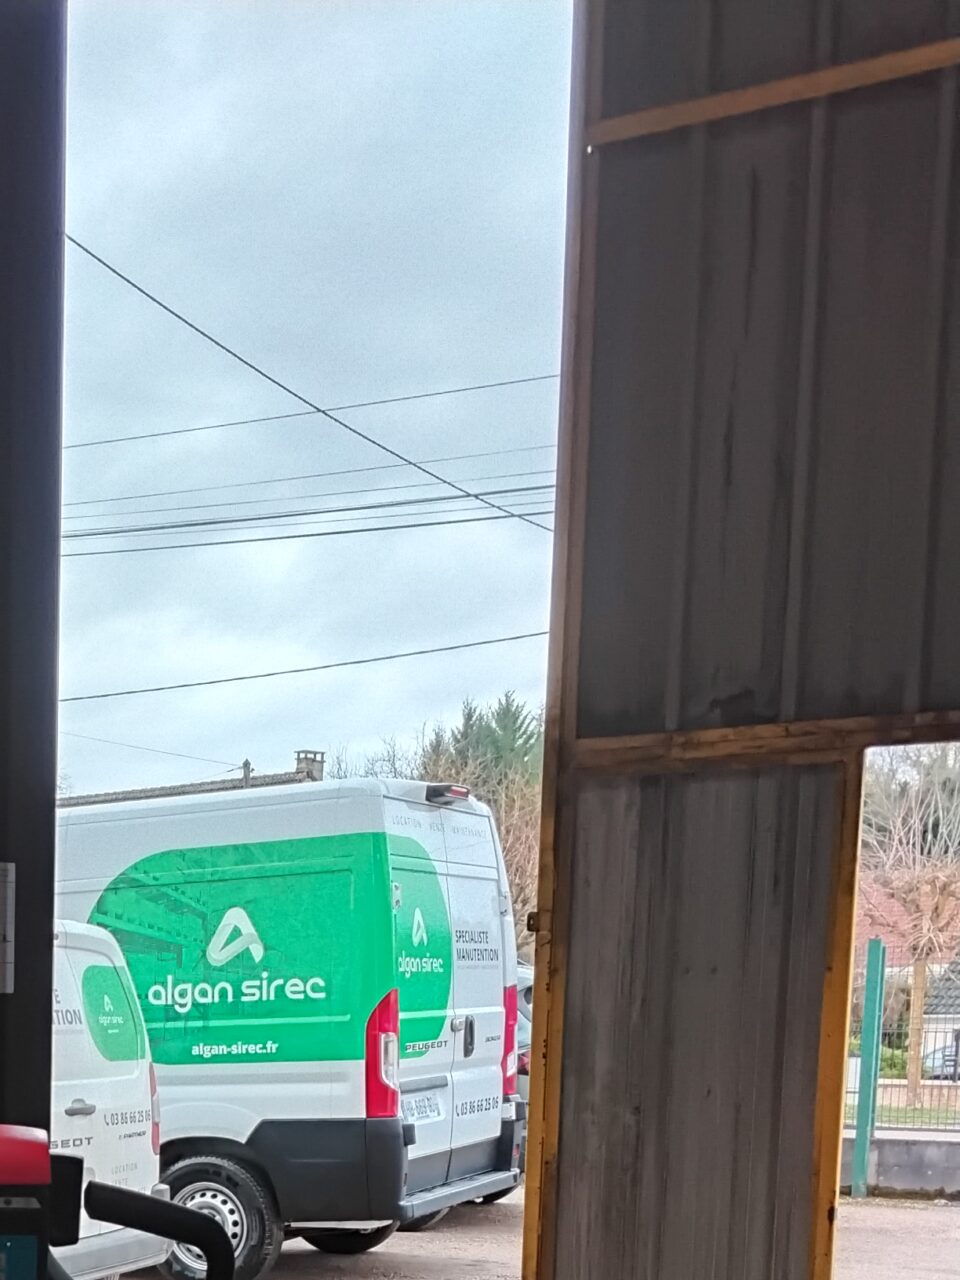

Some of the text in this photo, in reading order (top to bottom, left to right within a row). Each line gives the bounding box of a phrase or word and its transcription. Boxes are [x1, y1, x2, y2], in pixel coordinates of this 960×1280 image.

[456, 948, 499, 962] MANUTENTION
[398, 950, 444, 978] algan sirec
[147, 971, 327, 1014] algan sirec
[191, 1040, 280, 1058] algan-sirec.fr
[404, 1040, 449, 1051] PEUGEOT
[460, 1096, 499, 1116] 03 86 66 25 06
[111, 1113, 119, 1126] 03
[137, 1110, 144, 1123] 25
[50, 1137, 94, 1150] GEOT
